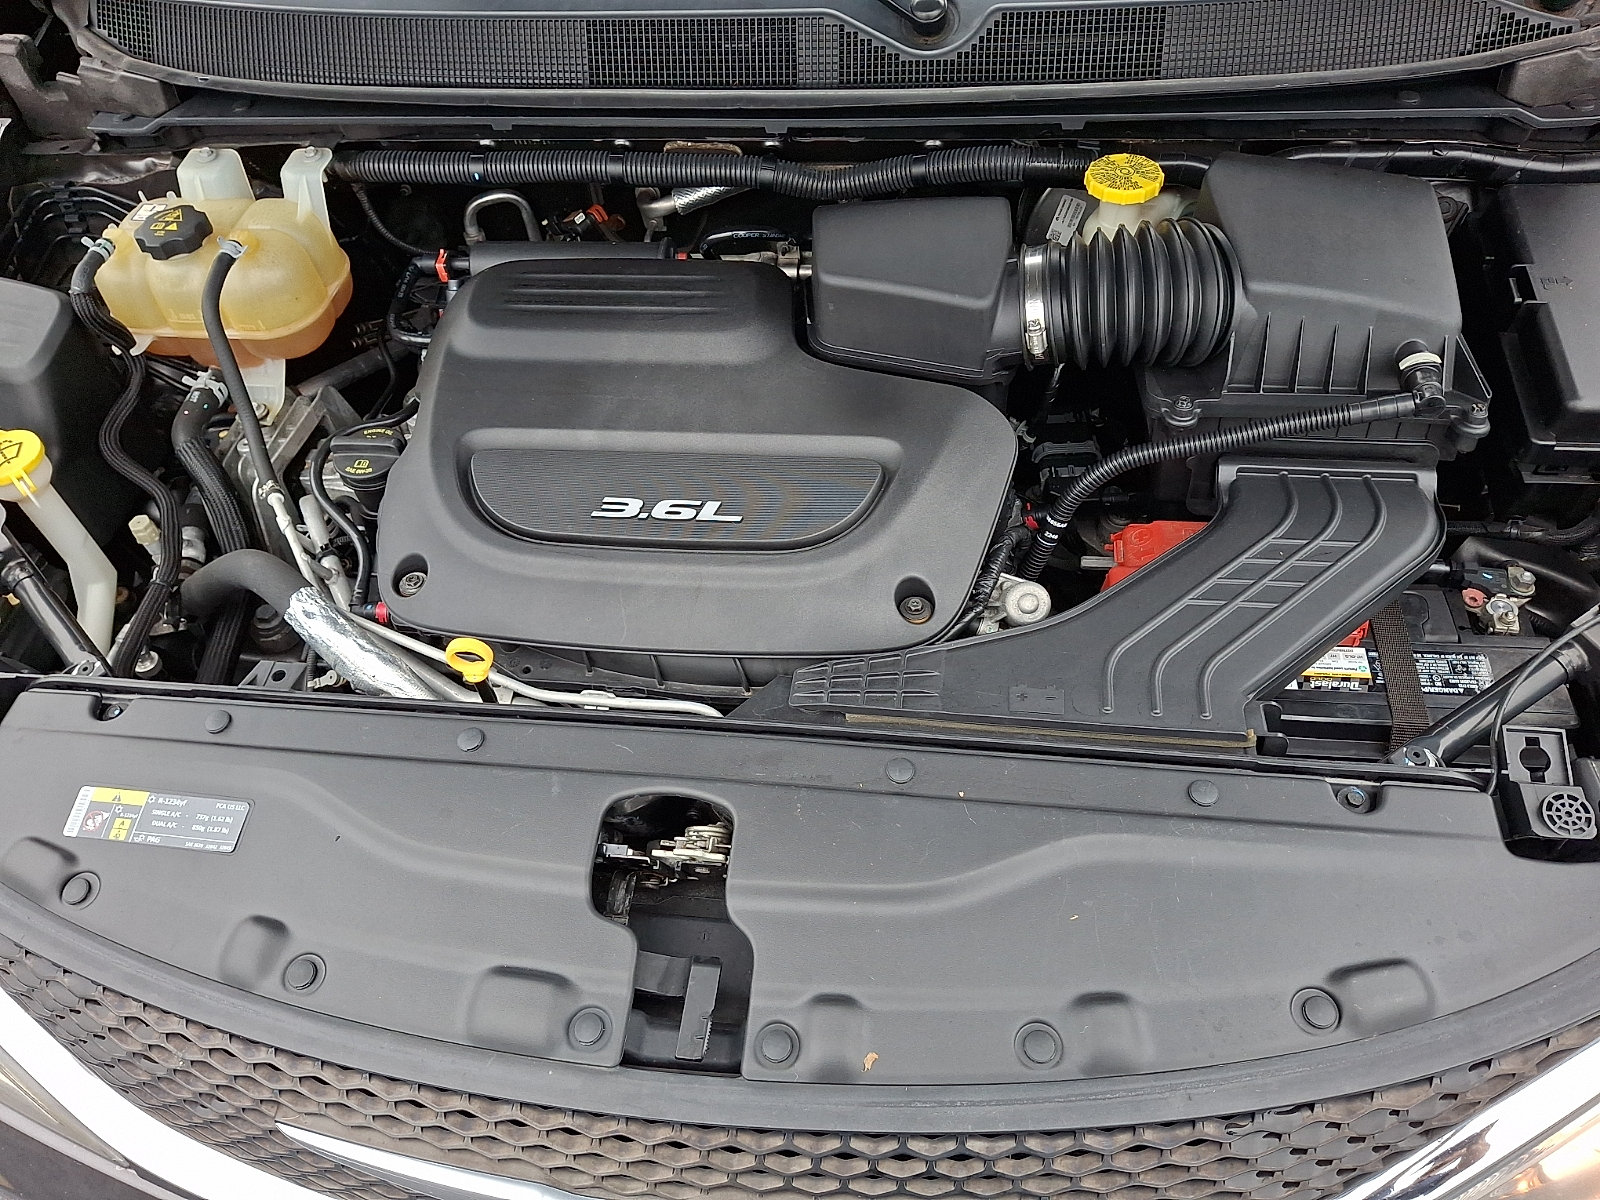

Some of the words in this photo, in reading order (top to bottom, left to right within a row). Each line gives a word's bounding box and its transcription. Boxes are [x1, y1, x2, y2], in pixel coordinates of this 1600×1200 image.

[590, 496, 744, 523] 3.6L
[1309, 680, 1362, 690] Duralast
[158, 797, 187, 807] R-1234yf
[152, 820, 167, 828] DUAL
[167, 821, 178, 829] A/C
